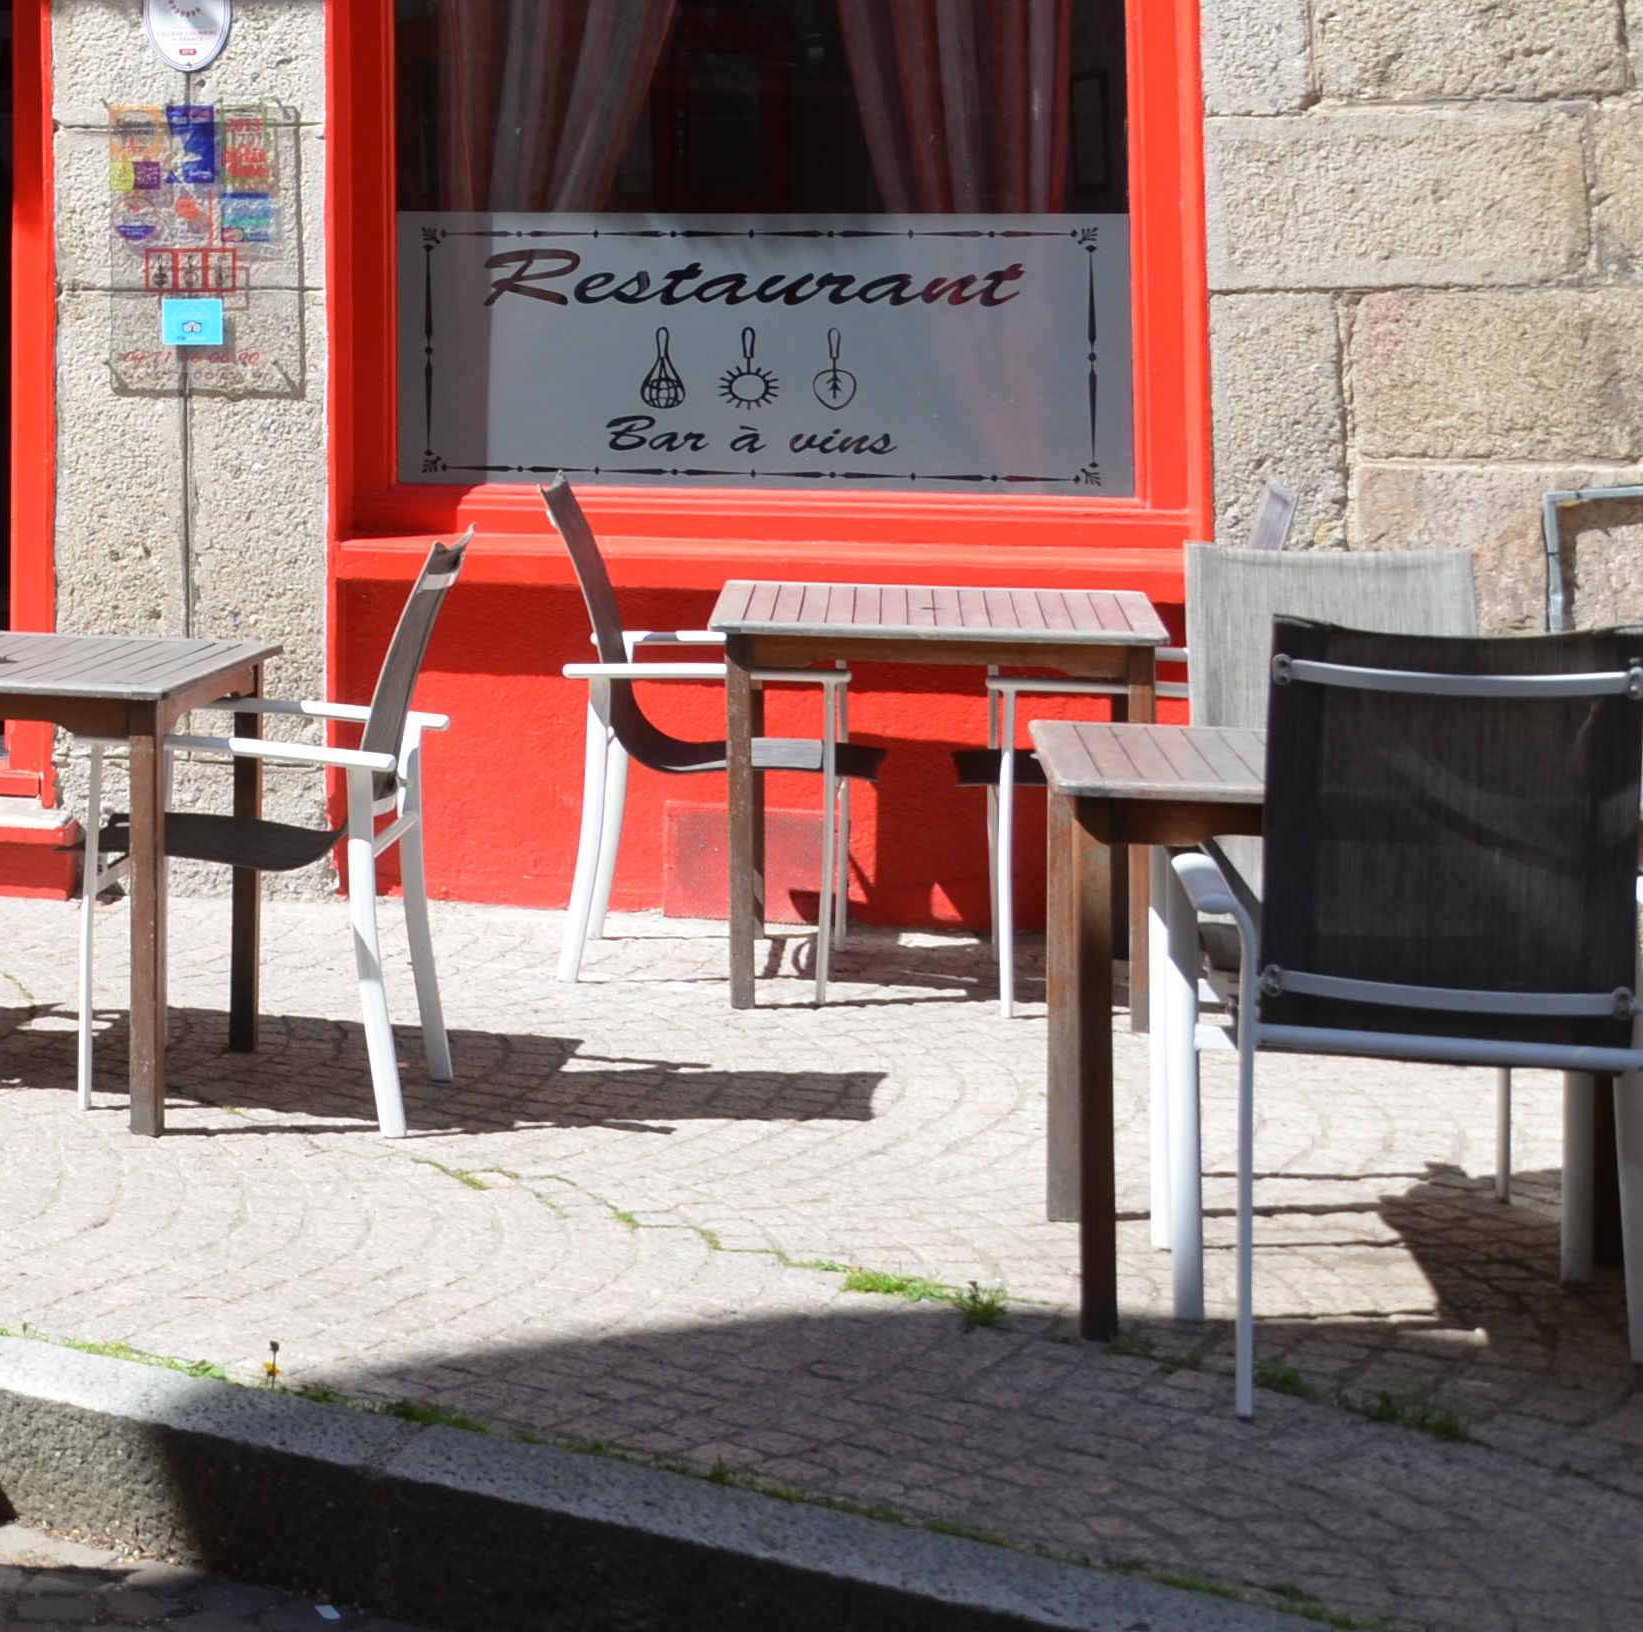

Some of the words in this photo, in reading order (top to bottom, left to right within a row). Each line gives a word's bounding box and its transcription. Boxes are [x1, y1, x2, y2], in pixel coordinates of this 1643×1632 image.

[483, 247, 1026, 308] Restaurant
[605, 414, 711, 454] Bar
[729, 425, 765, 455] à
[788, 425, 898, 455] vins
